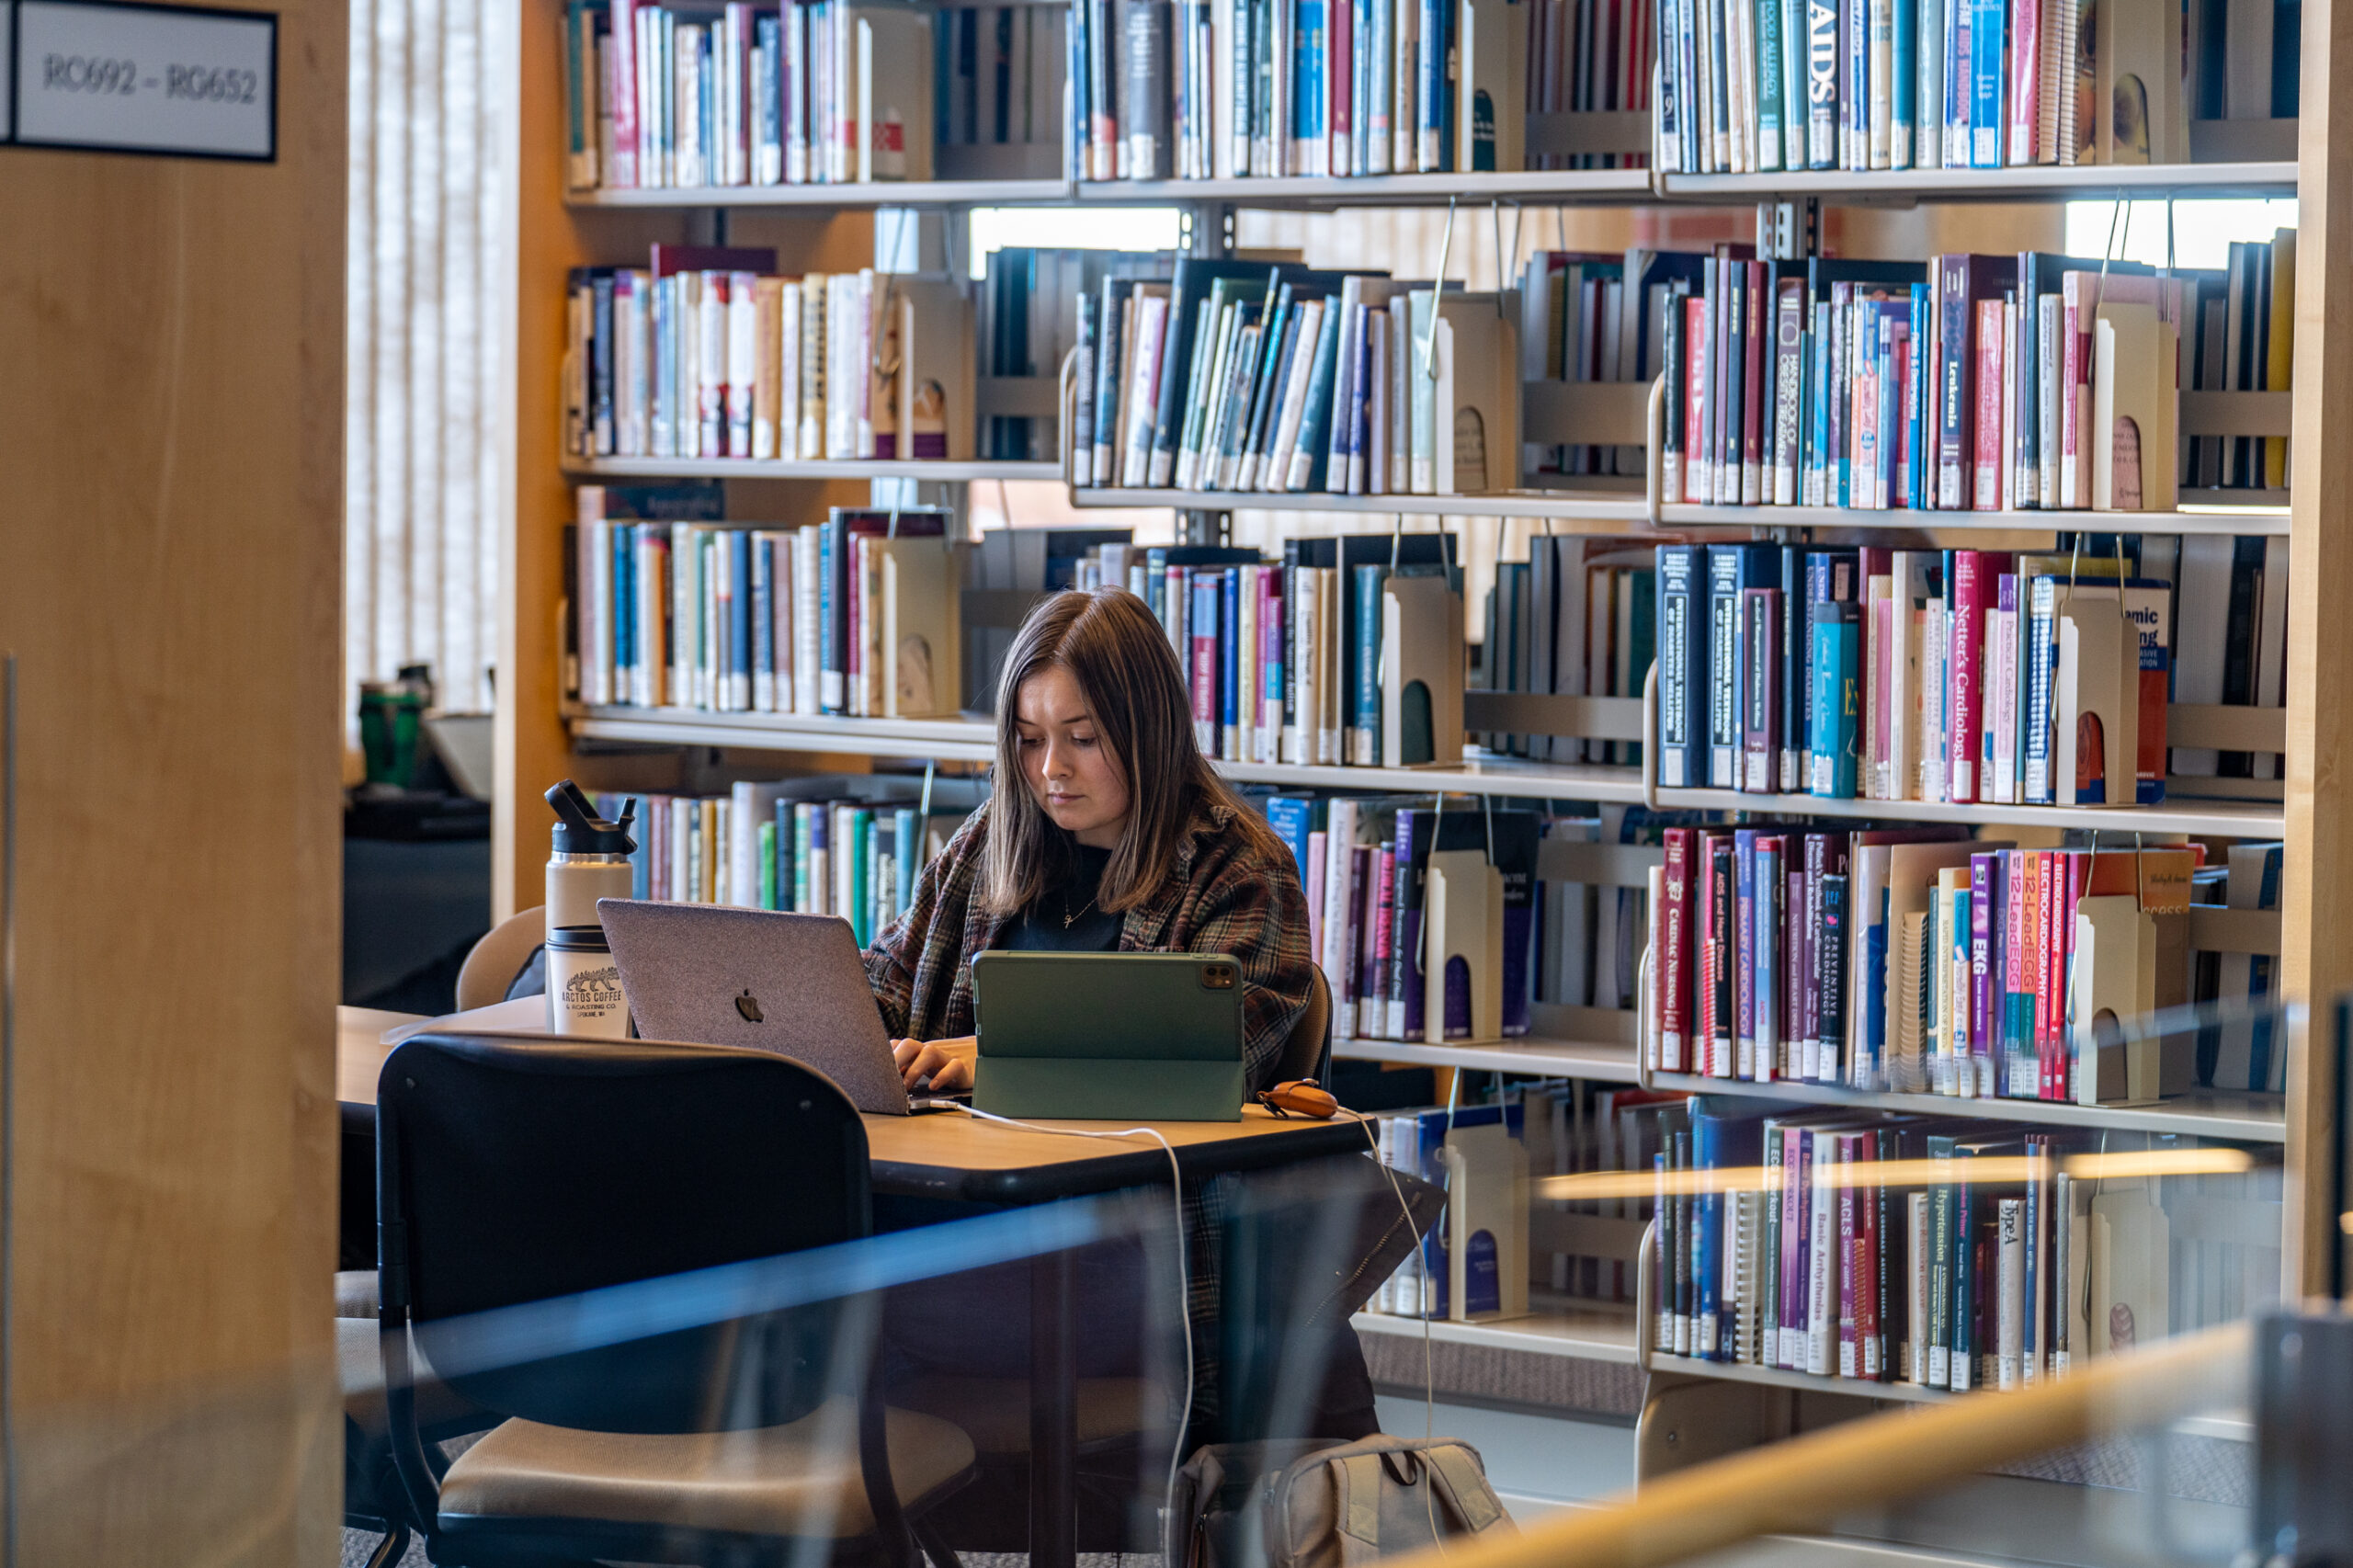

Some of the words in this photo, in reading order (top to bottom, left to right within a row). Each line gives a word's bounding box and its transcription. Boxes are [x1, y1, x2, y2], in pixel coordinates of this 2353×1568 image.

[1810, 1, 1836, 103] AIDS
[1779, 354, 1790, 400] OBESITY
[1788, 354, 1799, 426] HANDBOOK
[1948, 361, 1959, 427] Leukemia
[1788, 427, 1798, 446] OF
[1667, 608, 1676, 624] OF
[1675, 597, 1685, 684] INTERNATIONAL
[1716, 609, 1724, 626] OF
[1806, 566, 1814, 664] UNDERSTANDING
[1957, 604, 1970, 668] Netter's
[1666, 625, 1676, 677] DIABETES
[1715, 626, 1724, 679] DIABETES
[1723, 599, 1733, 685] INTERNATIONAL
[2006, 620, 2015, 664] Practical
[1665, 678, 1676, 733] MELLITUS
[1674, 684, 1684, 743] TEXTBOOK
[1714, 680, 1723, 733] MELLITUS
[1722, 686, 1733, 744] TEXTBOOK
[1804, 665, 1813, 721] DIABETES
[1953, 672, 1969, 760] Cardiology
[2002, 667, 2014, 724] Cardiology
[1807, 841, 1815, 869] Disease
[1807, 870, 1815, 885] and
[1815, 841, 1824, 875] Pollock's
[1716, 872, 1725, 895] AIDS
[1716, 897, 1724, 915] and
[1814, 877, 1824, 911] Textbook
[2053, 864, 2063, 953] ELECTROCARDIOGRAPHY
[1668, 908, 1680, 959] CARDIAC
[1716, 916, 1725, 943] Heart
[1739, 897, 1749, 951] PRIMARY
[1791, 913, 1800, 962] NUTRITION
[1806, 886, 1814, 940] Rehabilitation
[2039, 860, 2050, 997] ELECTROCARDIOGRAPHY
[1716, 944, 1725, 983] Disease
[1813, 922, 1823, 981] Cardiovascular
[1823, 935, 1831, 1017] CARDIOLOGY
[1830, 936, 1839, 1017] PREVENTIVE
[1972, 938, 1987, 975] EKG
[562, 992, 591, 1003] ARCTOS
[594, 990, 622, 1003] COFFEE
[1667, 959, 1678, 1010] NURSING
[1738, 952, 1749, 1036] CARDIOLOGY
[1771, 1149, 1781, 1173] ECG
[1802, 1153, 1811, 1177] Basic
[1768, 1175, 1780, 1222] Workout
[1800, 1180, 1810, 1241] Dysrhythmias
[1841, 1197, 1852, 1236] ACLS
[1960, 1210, 1968, 1238] Primer
[2000, 1205, 2019, 1234] Type
[1816, 1213, 1826, 1246] Basic
[1934, 1188, 1948, 1262] Hypertension
[2005, 1234, 2019, 1245] A
[1814, 1250, 1825, 1322] Arrhythmias
